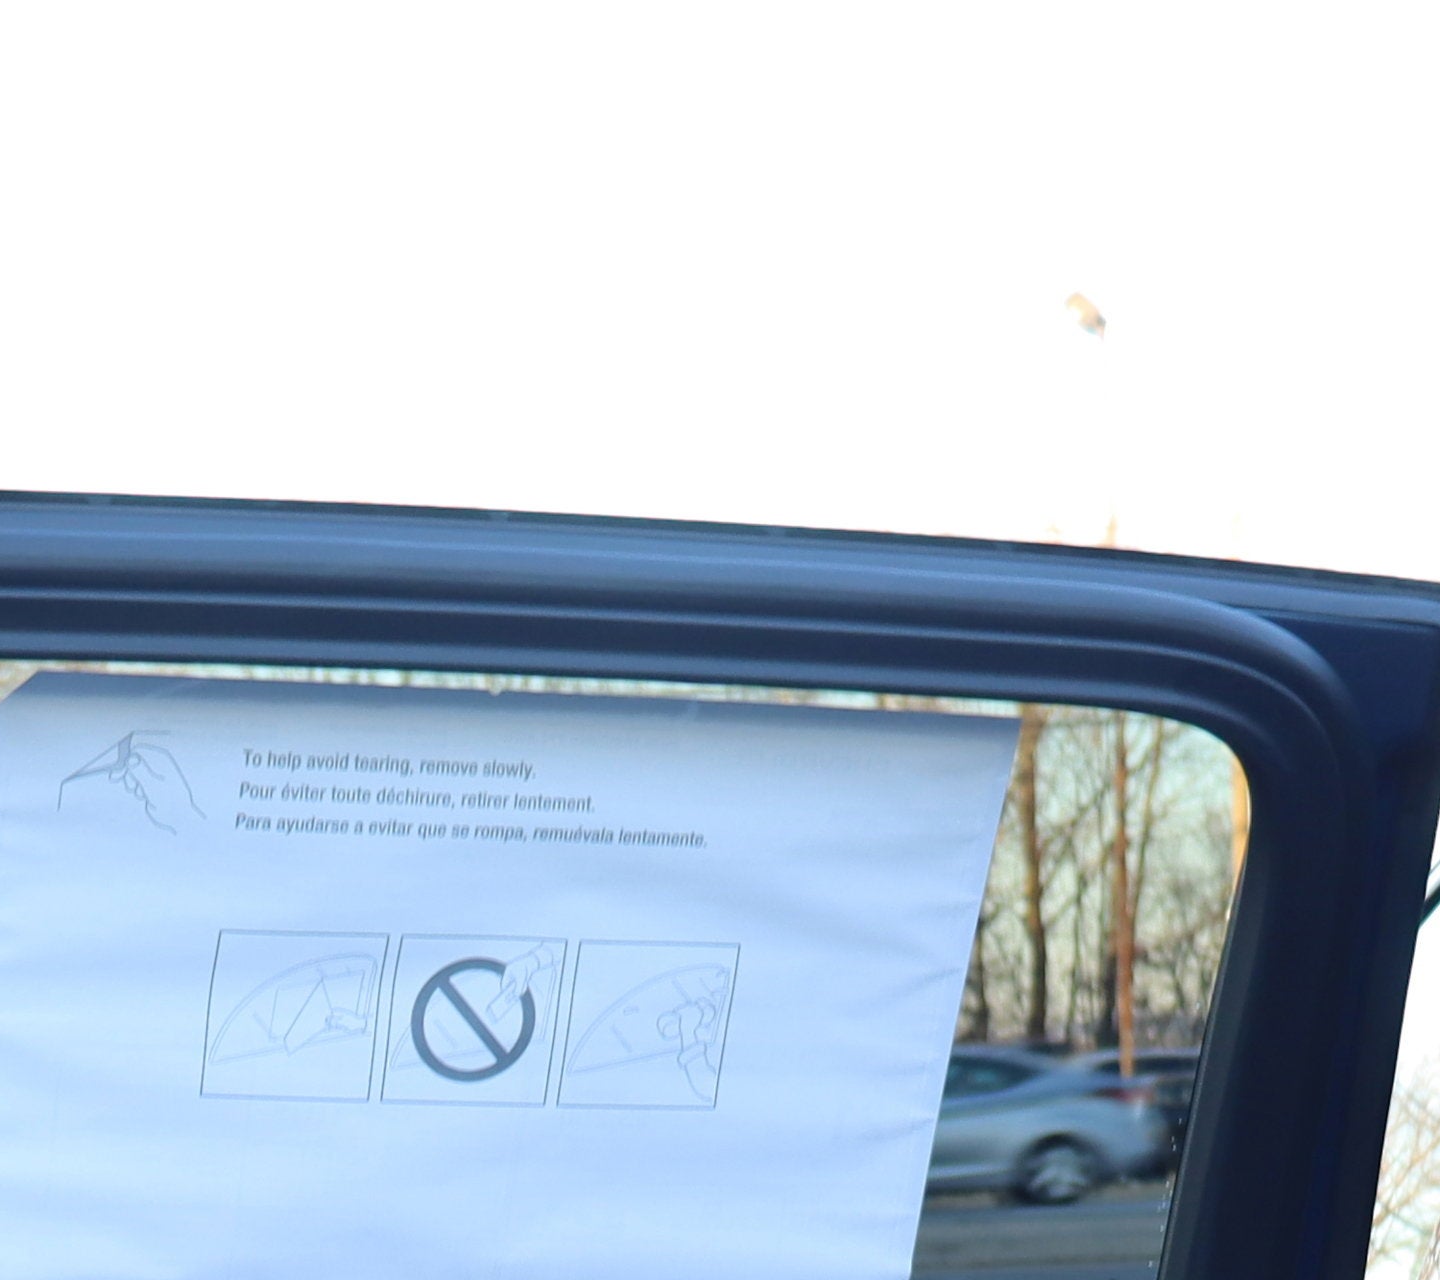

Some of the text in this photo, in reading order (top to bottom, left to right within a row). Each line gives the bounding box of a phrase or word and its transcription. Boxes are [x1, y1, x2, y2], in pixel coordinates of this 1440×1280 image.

[242, 749, 536, 782] To help avoid tearing, remove slowly.
[239, 781, 595, 813] Pour éviter toute déchirure, retirer lentement.
[235, 812, 708, 849] Para ayudarse a evitar que se rompa, remuévala lentamente.
